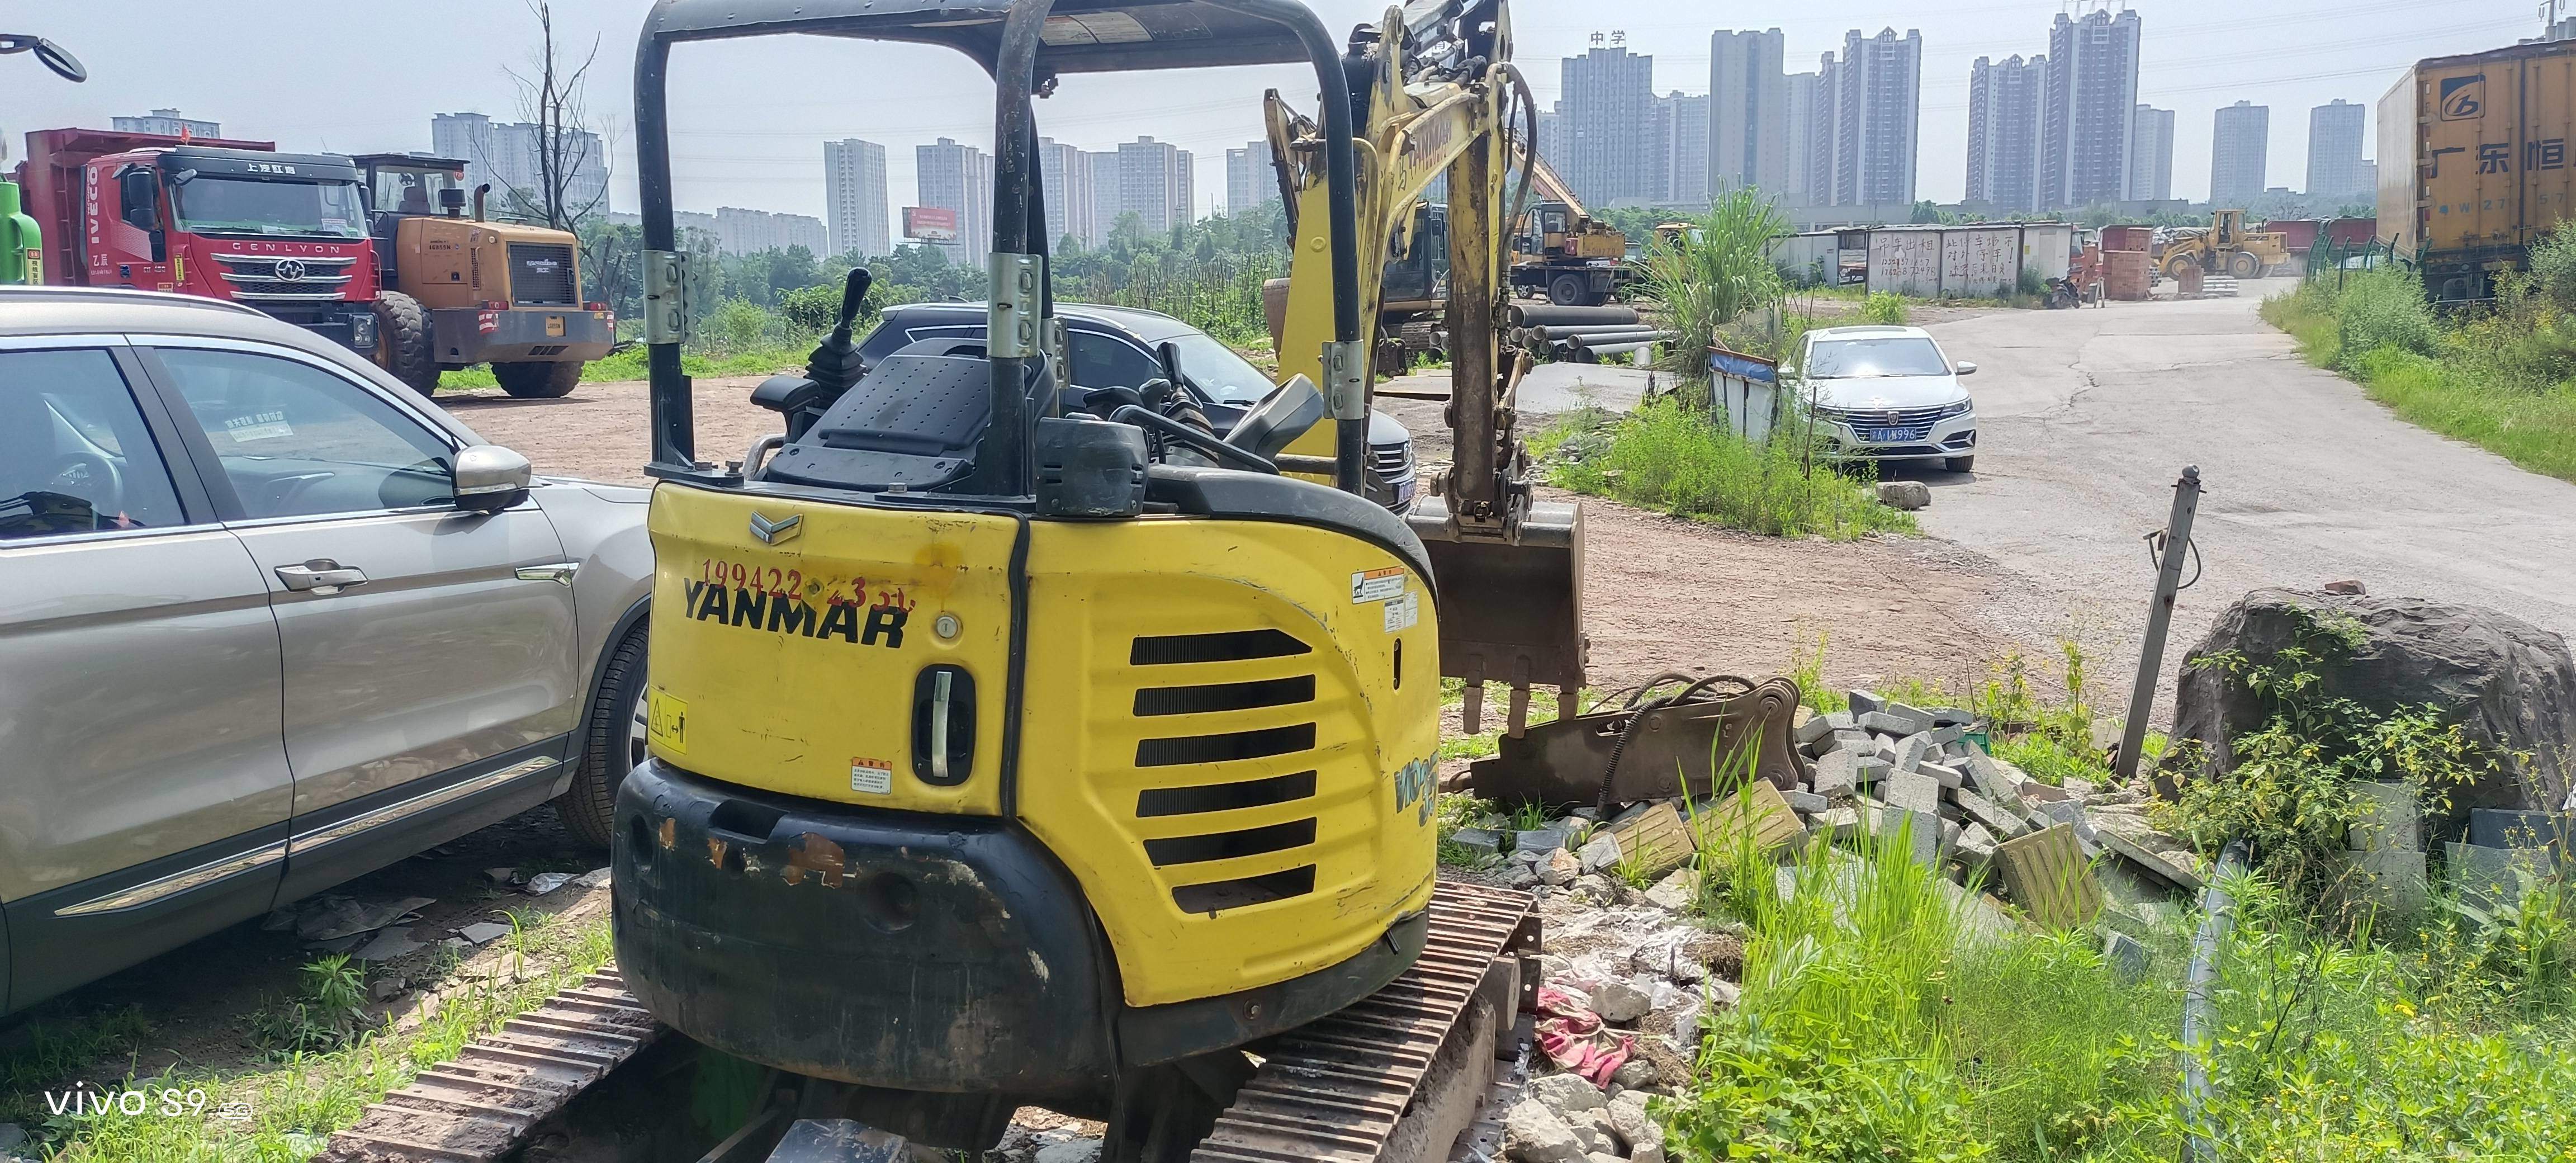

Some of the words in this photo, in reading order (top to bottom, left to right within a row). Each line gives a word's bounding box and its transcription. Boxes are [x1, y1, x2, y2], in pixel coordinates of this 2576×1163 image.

[1590, 30, 1625, 45] 中学
[2430, 138, 2576, 179] 广东恒
[90, 167, 100, 244] IVECO
[233, 243, 339, 253] GENLYON
[684, 578, 911, 649] YANMAR
